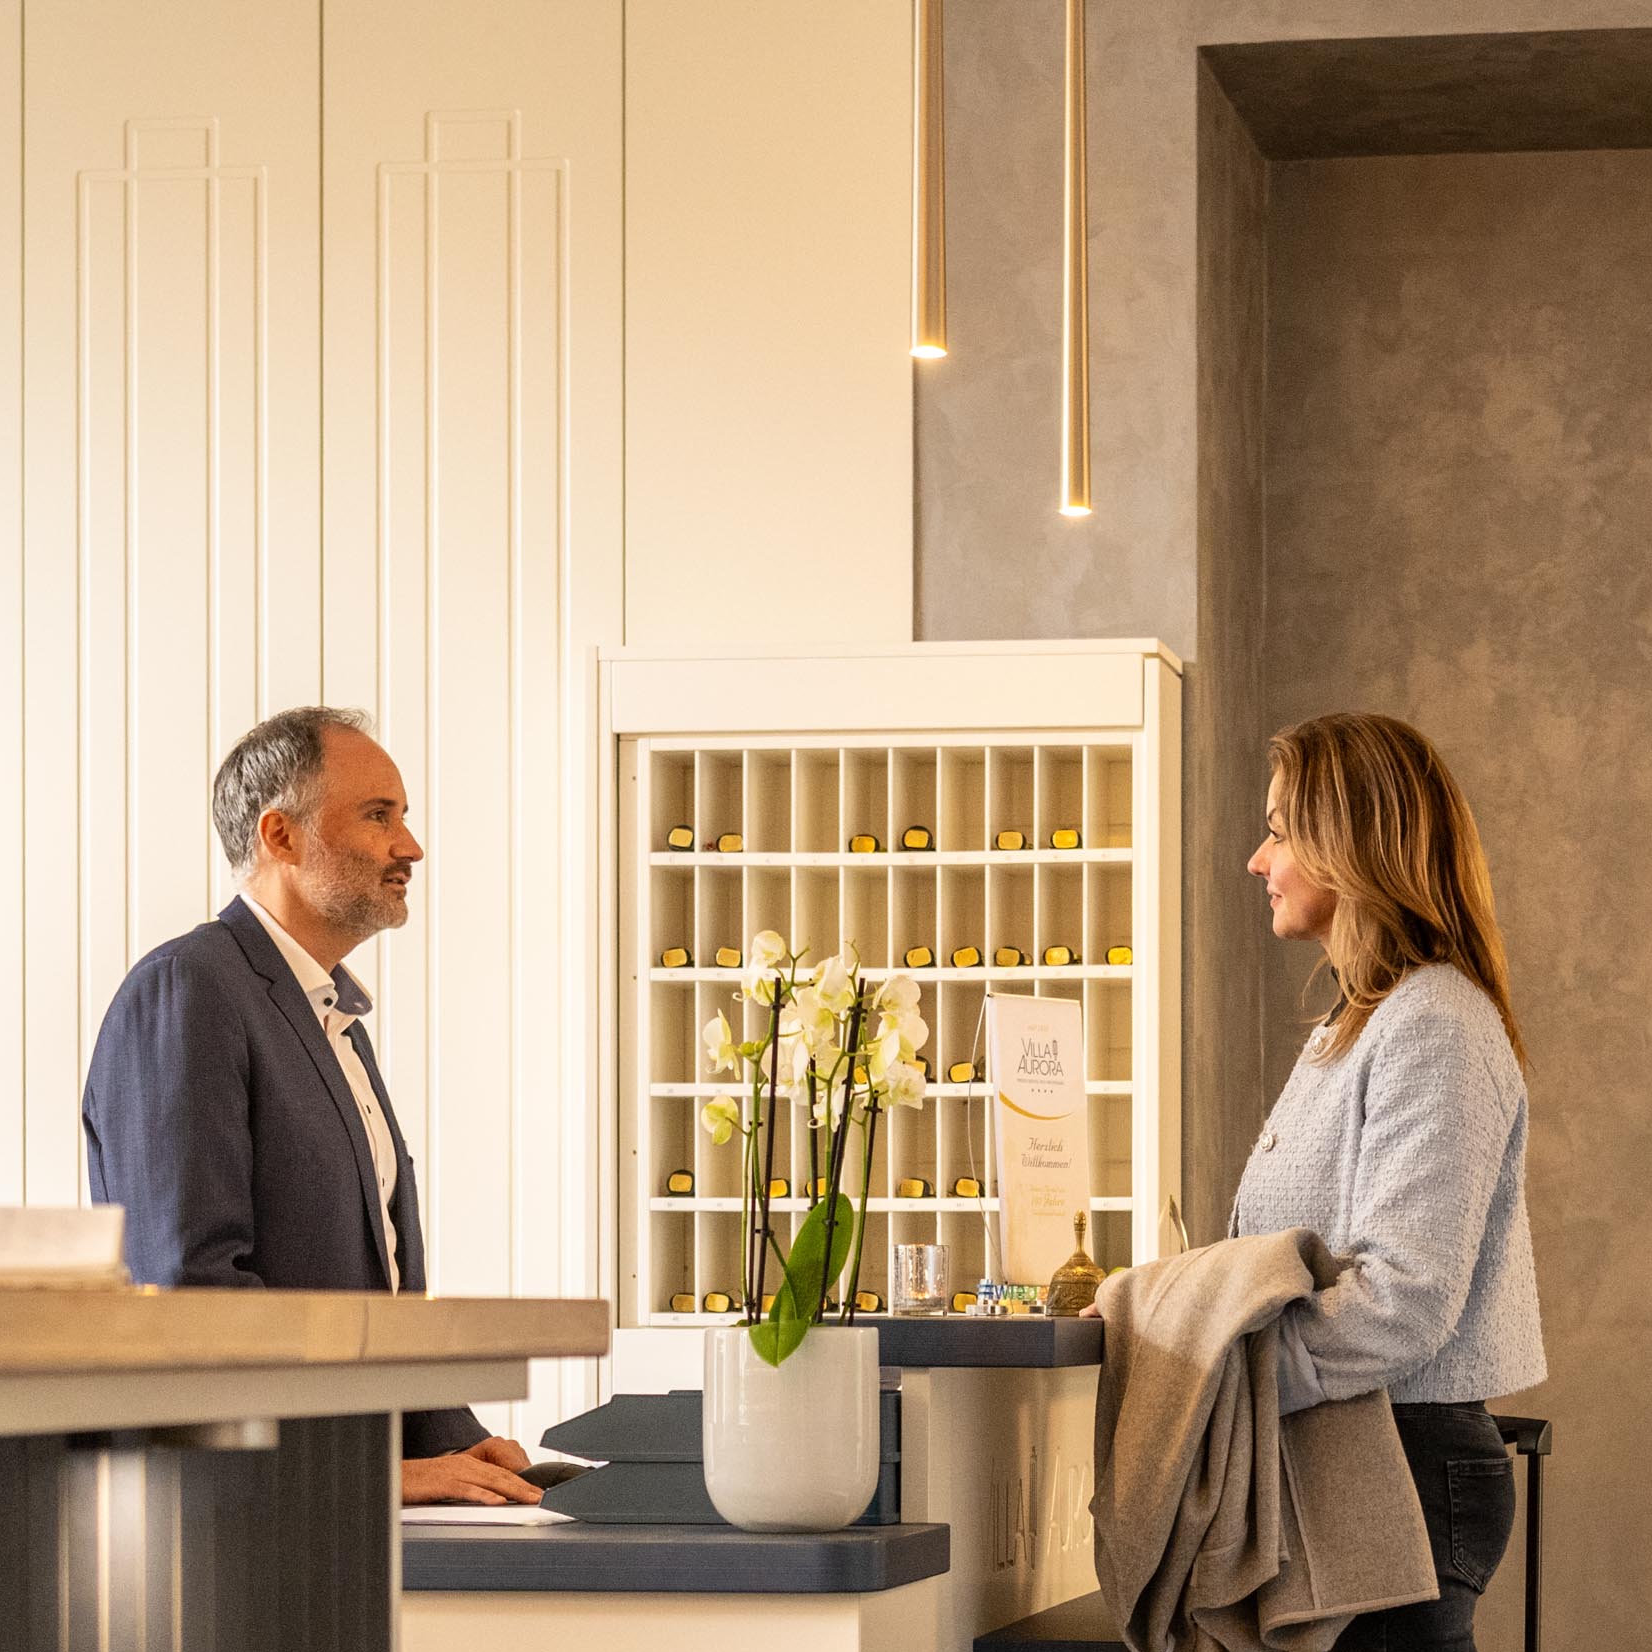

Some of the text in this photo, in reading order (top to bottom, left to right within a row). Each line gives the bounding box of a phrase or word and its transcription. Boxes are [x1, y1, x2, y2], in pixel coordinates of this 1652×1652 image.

[1020, 1036, 1053, 1059] VILLA
[1016, 1053, 1065, 1077] AURORA
[1027, 1137, 1064, 1153] Herzlich
[1020, 1153, 1073, 1169] Willkommen!
